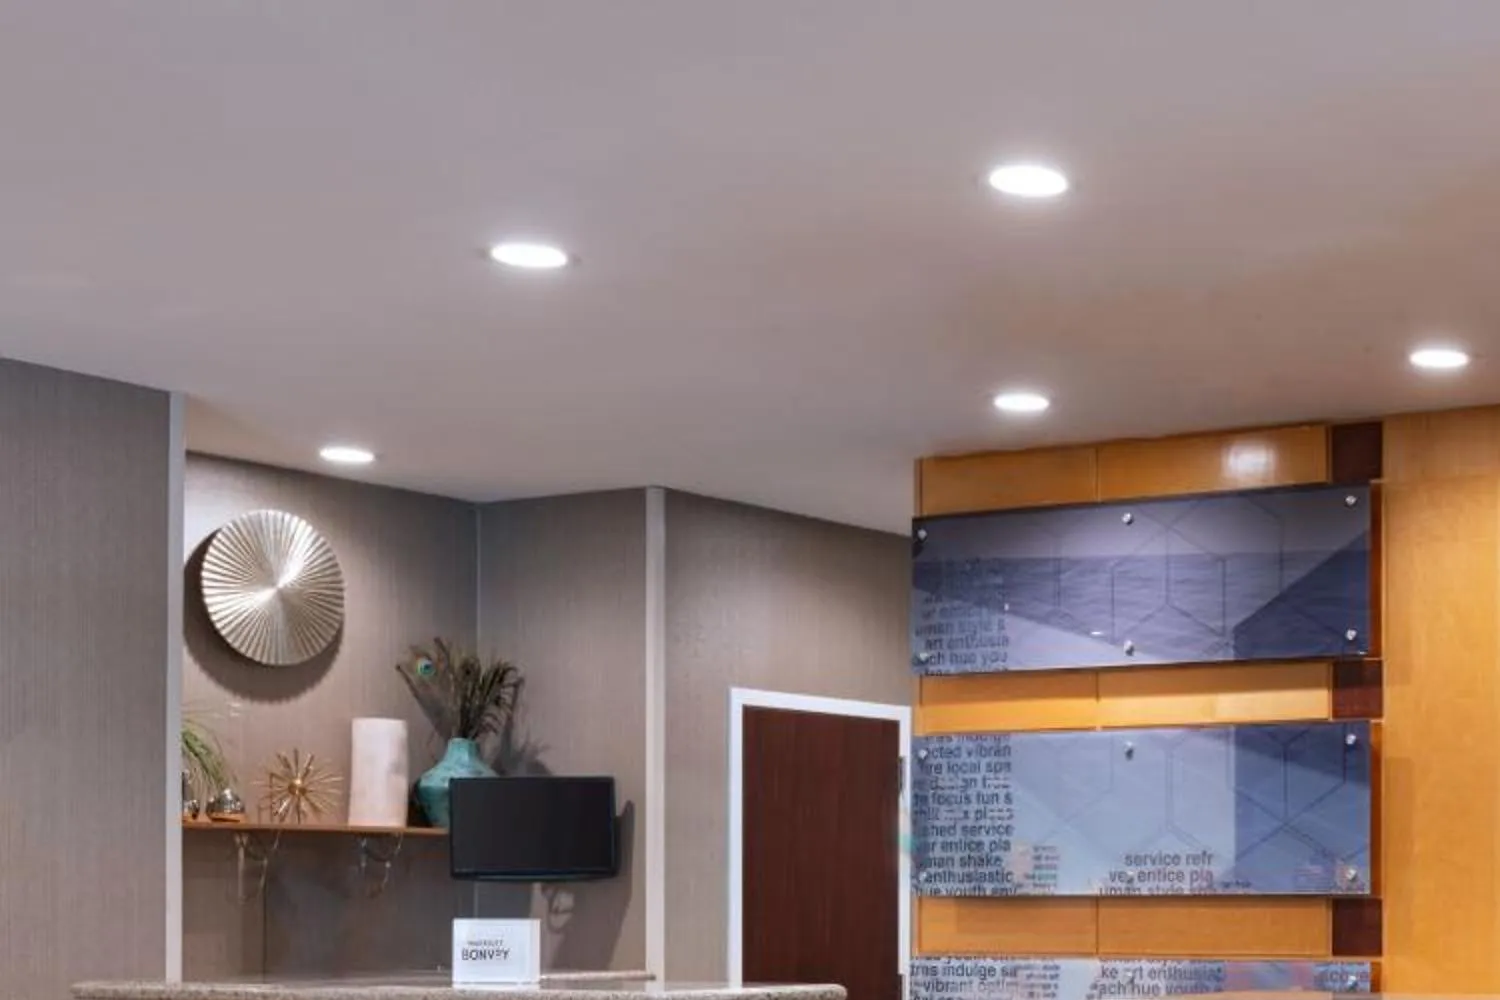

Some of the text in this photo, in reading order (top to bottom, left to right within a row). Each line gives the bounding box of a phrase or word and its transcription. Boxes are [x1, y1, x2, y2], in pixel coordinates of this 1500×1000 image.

[1124, 850, 1181, 867] service
[1109, 869, 1134, 883] ve
[1137, 866, 1185, 883] entice
